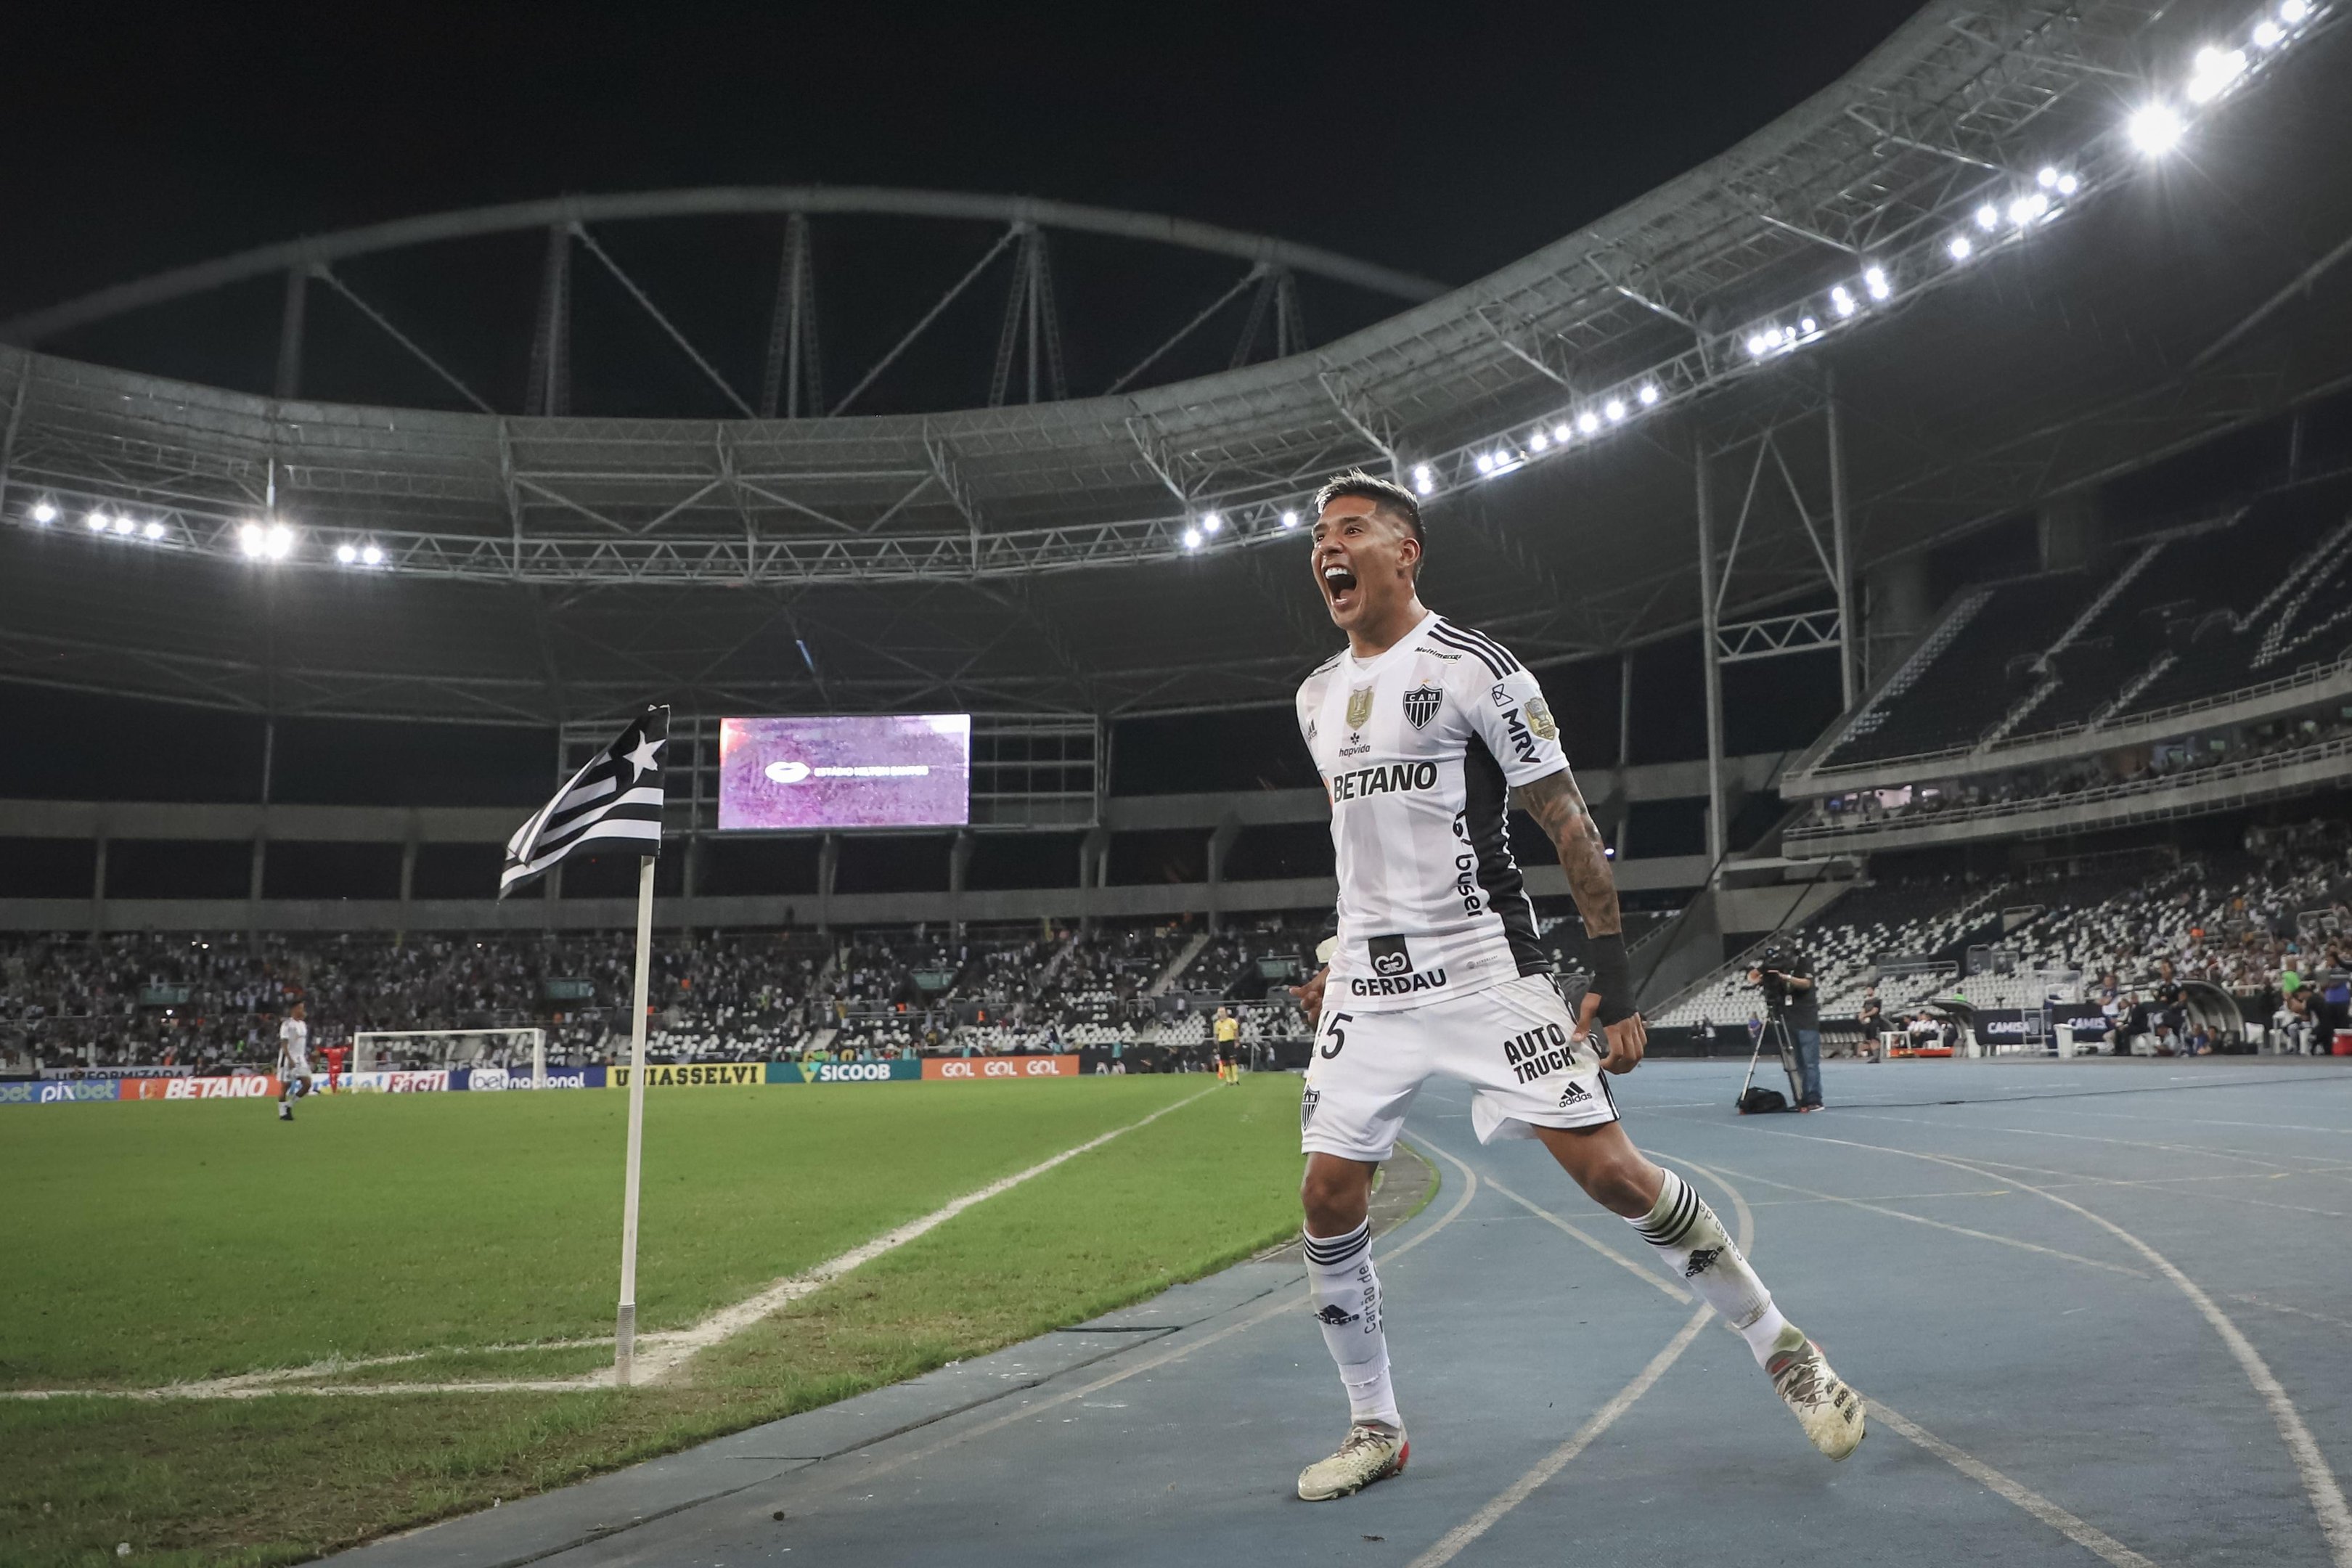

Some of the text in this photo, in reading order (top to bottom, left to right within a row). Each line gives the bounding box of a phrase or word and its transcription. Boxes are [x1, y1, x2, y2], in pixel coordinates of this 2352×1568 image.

[1501, 708, 1541, 763] MRV
[1339, 744, 1371, 757] hapvida
[1334, 761, 1437, 804] BETANO
[1455, 854, 1483, 917] buser
[1351, 968, 1447, 996] GERDAU
[1503, 1023, 1566, 1066] AUTO
[616, 1066, 757, 1086] UIASSELVI
[820, 1063, 891, 1081] SICOOB
[942, 1060, 1060, 1077] GOL GOL GOL
[1514, 1046, 1576, 1085] TRUCK
[41, 1079, 116, 1103] pixbet
[164, 1076, 269, 1099] BETANO
[386, 1072, 445, 1093] Fácil
[1559, 1093, 1592, 1108] adidas
[1357, 1265, 1373, 1283] de
[1360, 1286, 1376, 1334] Cartão
